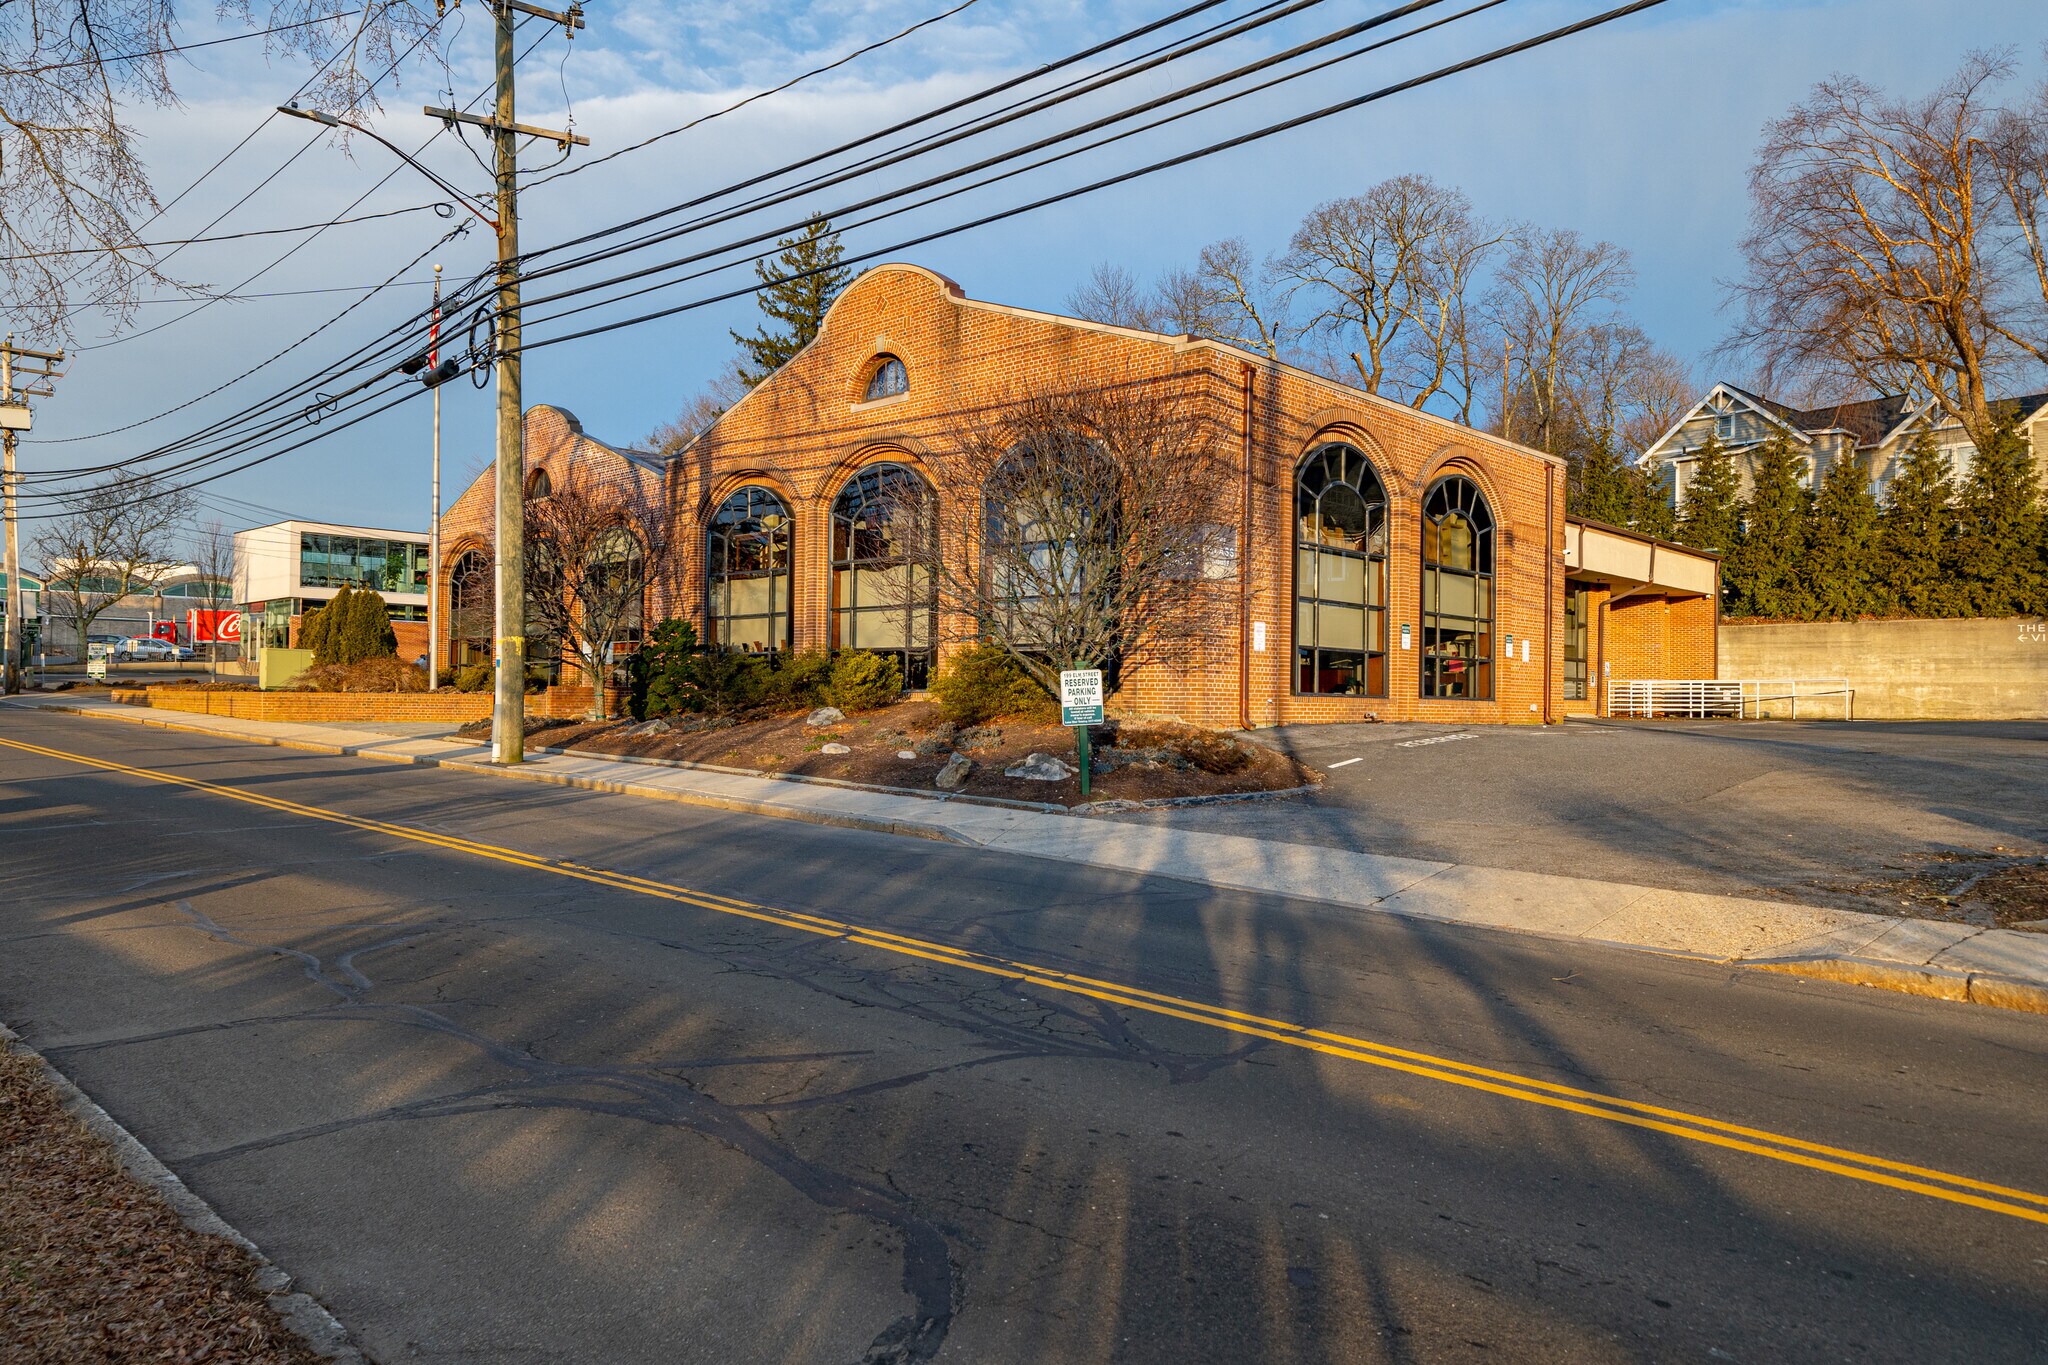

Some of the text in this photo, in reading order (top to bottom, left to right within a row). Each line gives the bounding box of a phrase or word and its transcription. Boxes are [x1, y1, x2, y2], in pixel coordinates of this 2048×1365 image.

[2017, 624, 2046, 632] THE
[2031, 634, 2046, 642] VI
[1065, 678, 1098, 687] RESERVED
[1068, 688, 1096, 696] PARKING
[1074, 697, 1091, 705] ONLY
